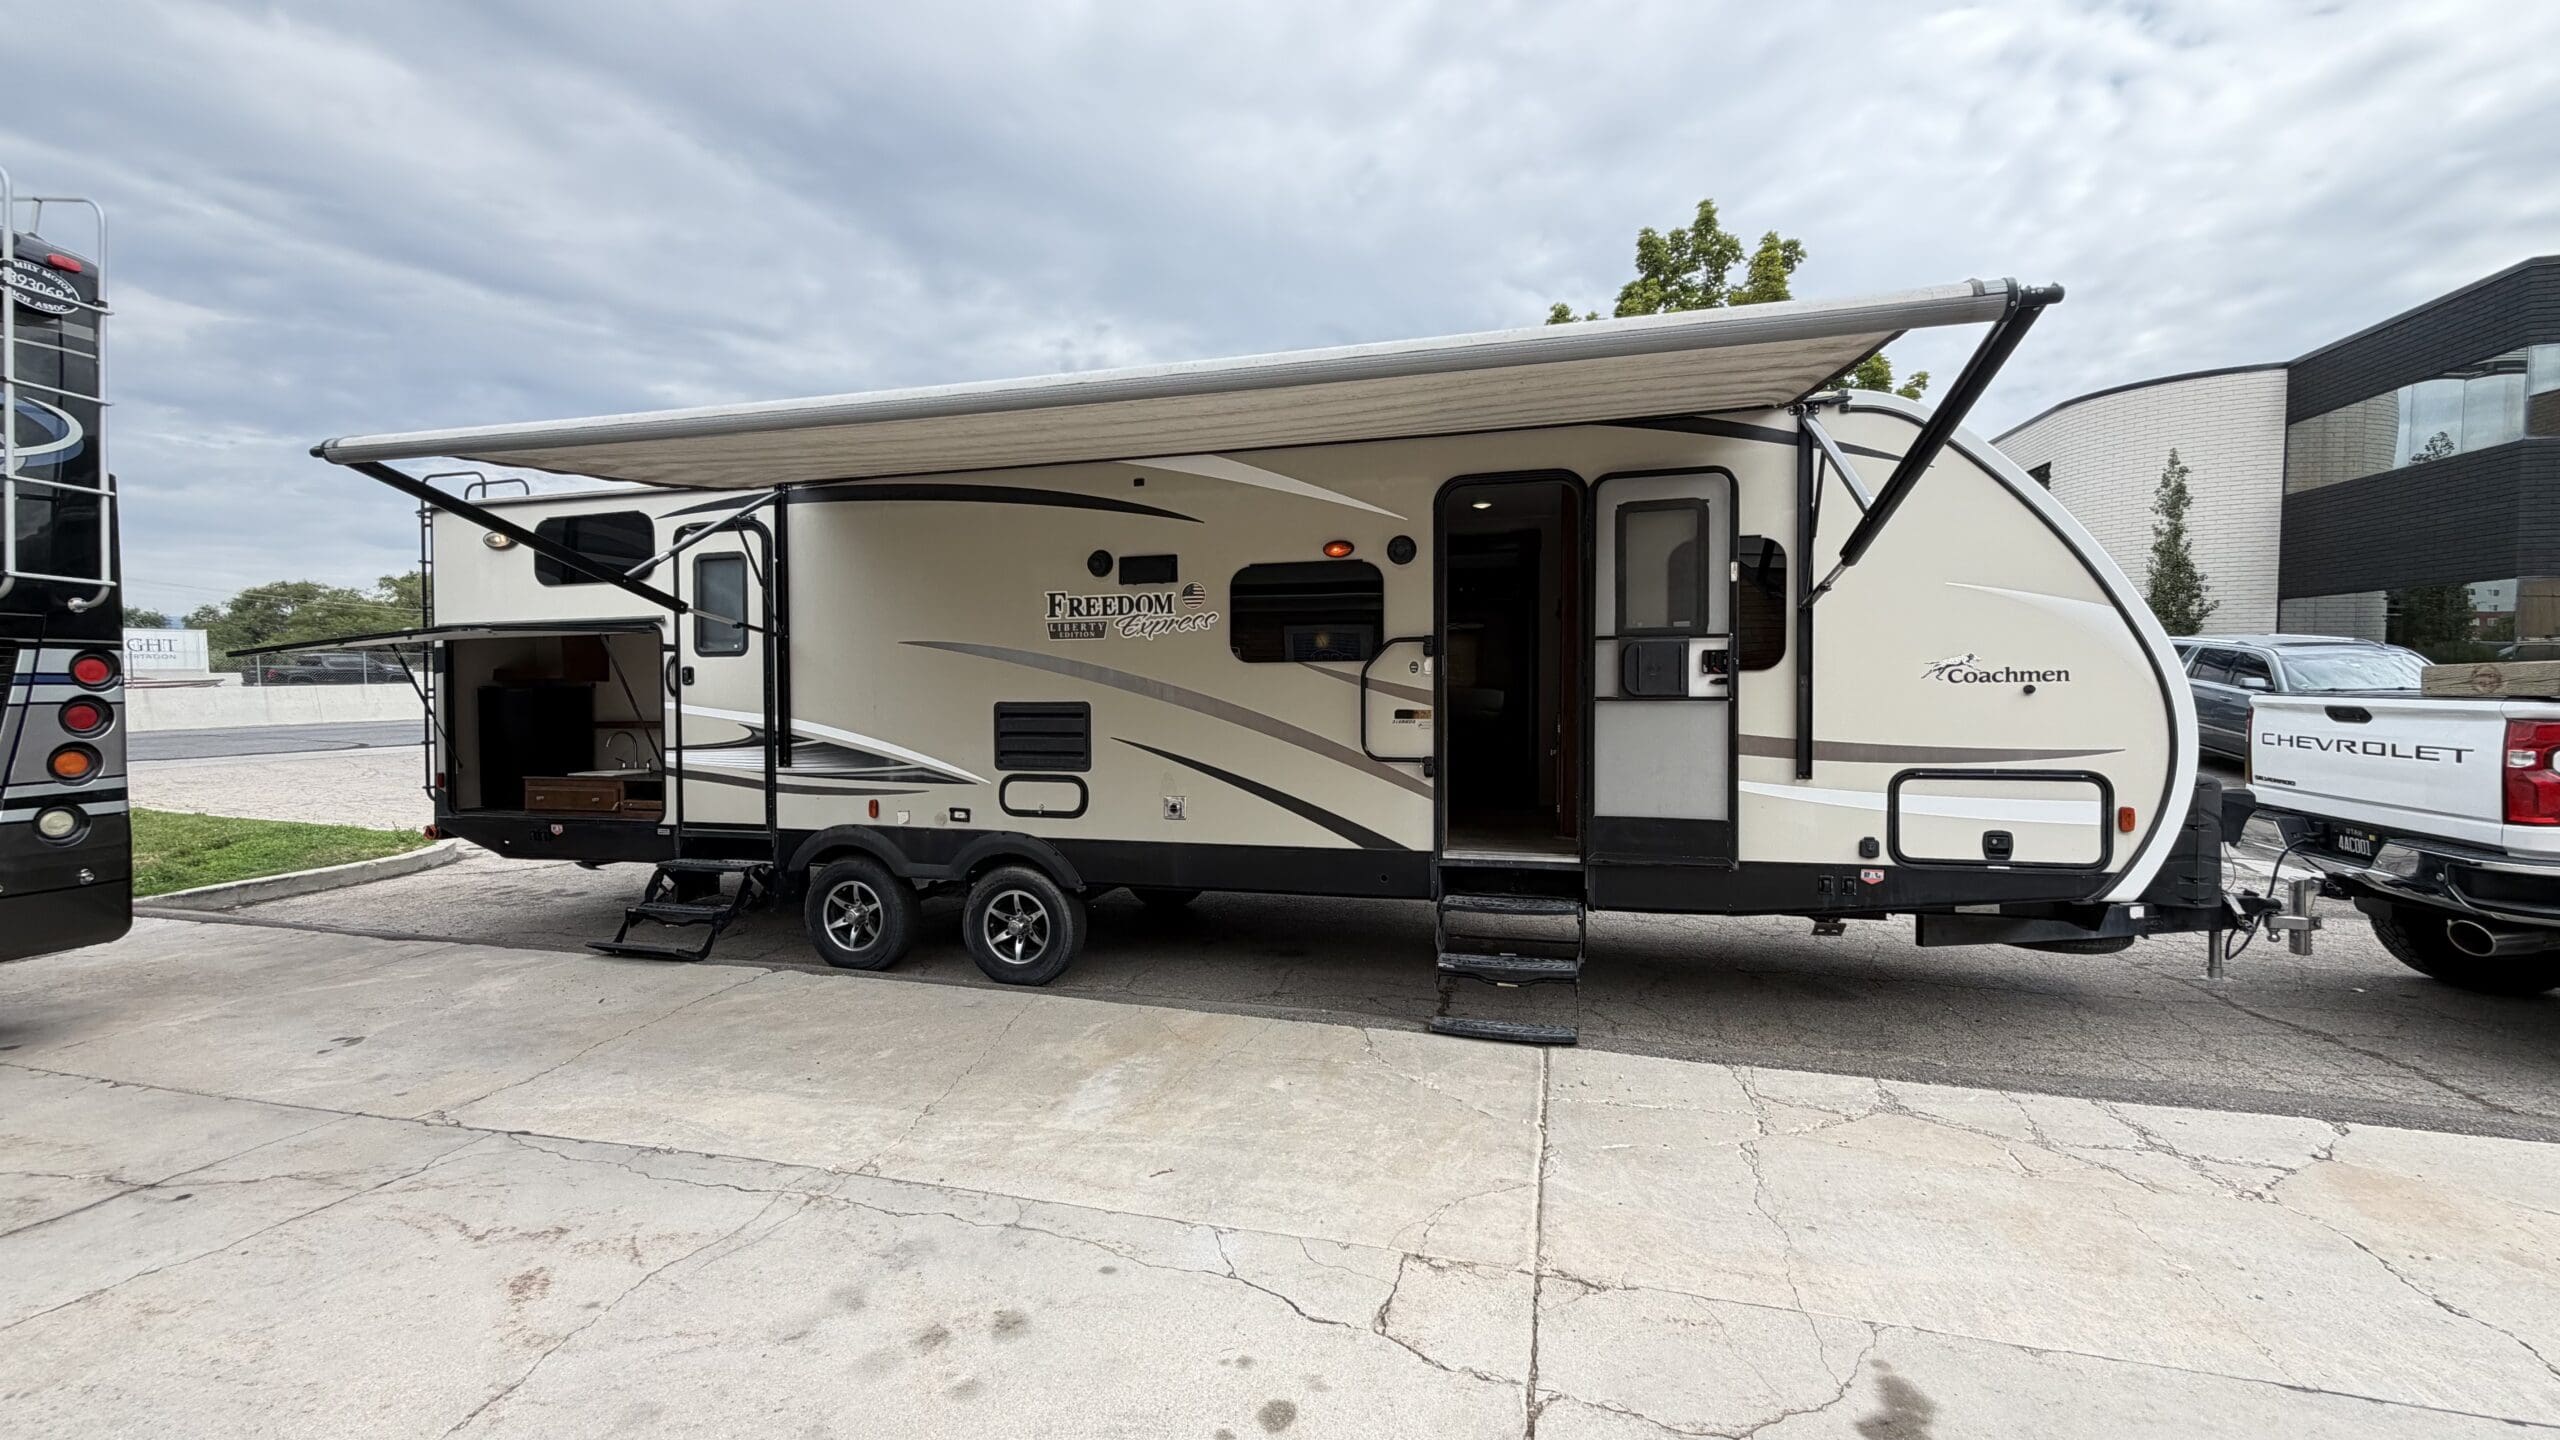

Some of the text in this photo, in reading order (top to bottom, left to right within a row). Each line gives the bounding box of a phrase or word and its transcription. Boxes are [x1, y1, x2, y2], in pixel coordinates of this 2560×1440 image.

[13, 260, 40, 273] MILY
[1046, 592, 1176, 619] FREEDOM
[1050, 623, 1105, 632] LIBERTY
[1115, 613, 1218, 638] Express
[127, 638, 178, 652] GHT
[1947, 667, 2071, 684] Coachmen
[2262, 733, 2475, 763] CHEVROLET
